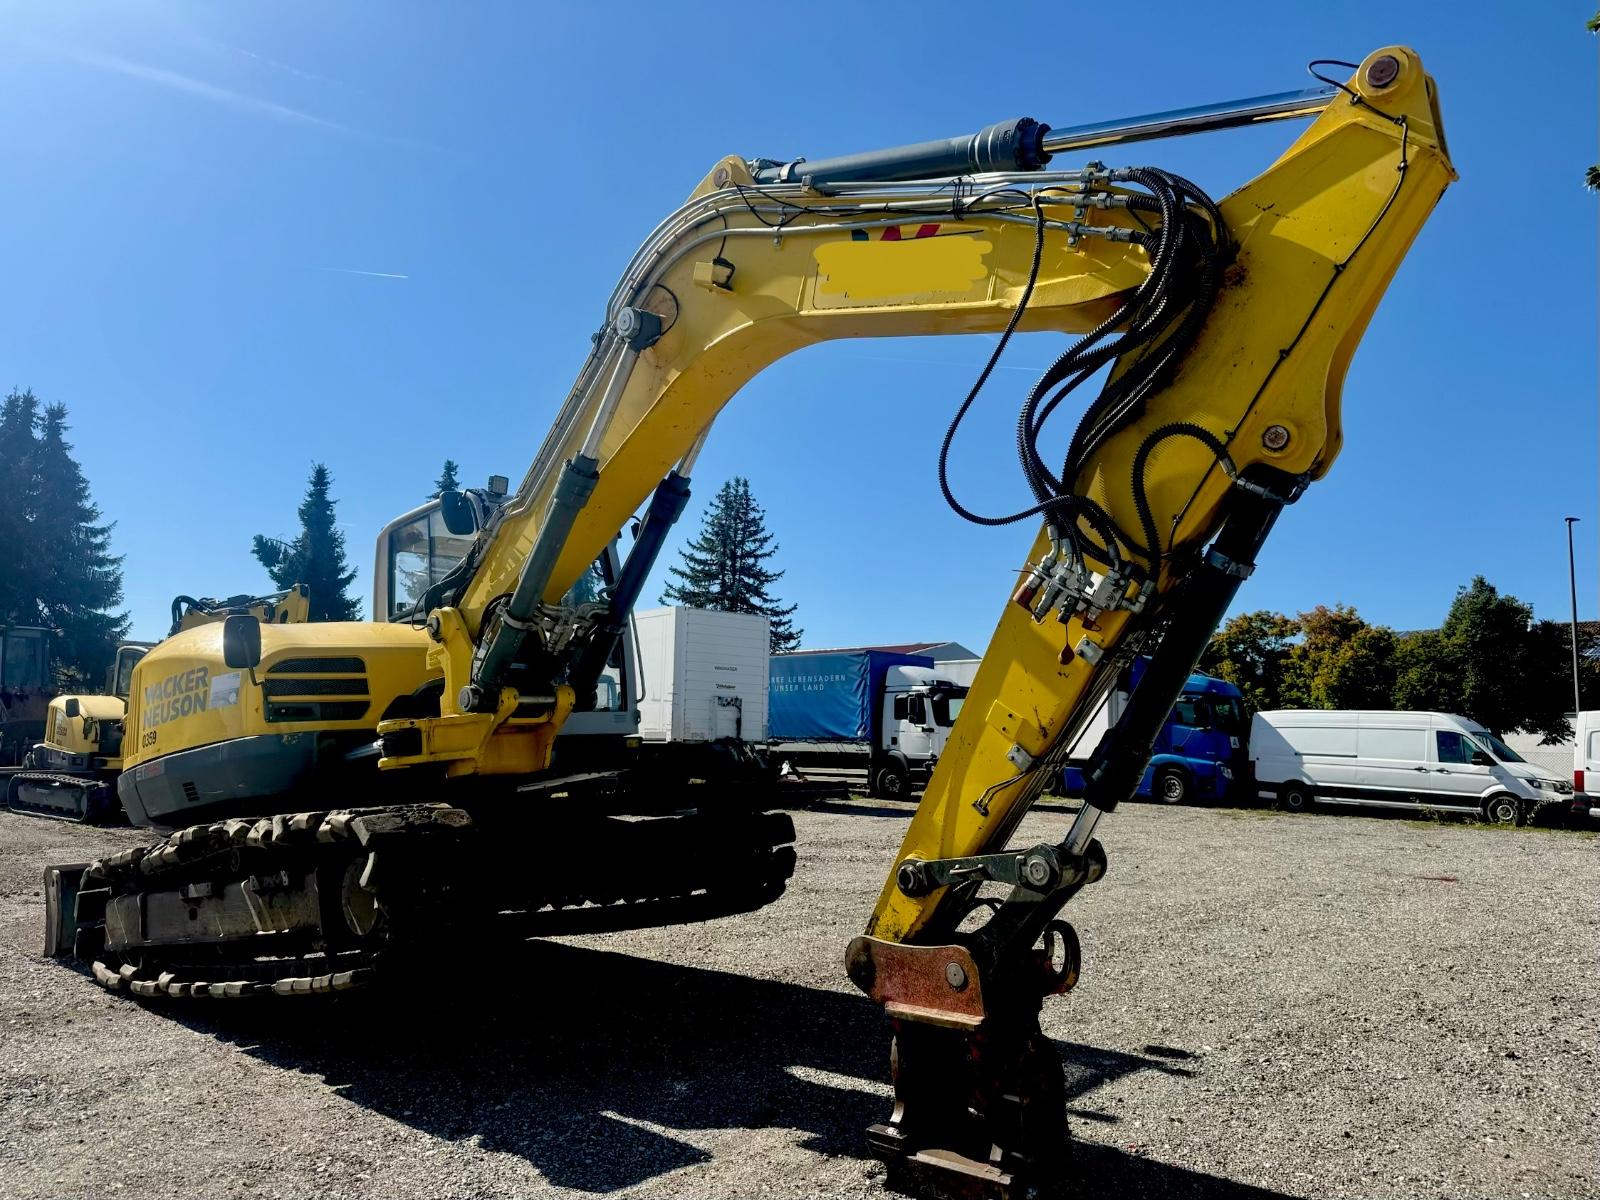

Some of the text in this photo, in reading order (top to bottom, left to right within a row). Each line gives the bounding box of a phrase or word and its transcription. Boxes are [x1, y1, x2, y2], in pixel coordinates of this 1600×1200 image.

[144, 666, 209, 707] WACKER
[774, 684, 799, 692] UNSER
[802, 683, 825, 692] LAND
[788, 674, 846, 683] LEBENSADERN
[143, 689, 208, 730] NEUSON
[142, 730, 157, 749] 0359
